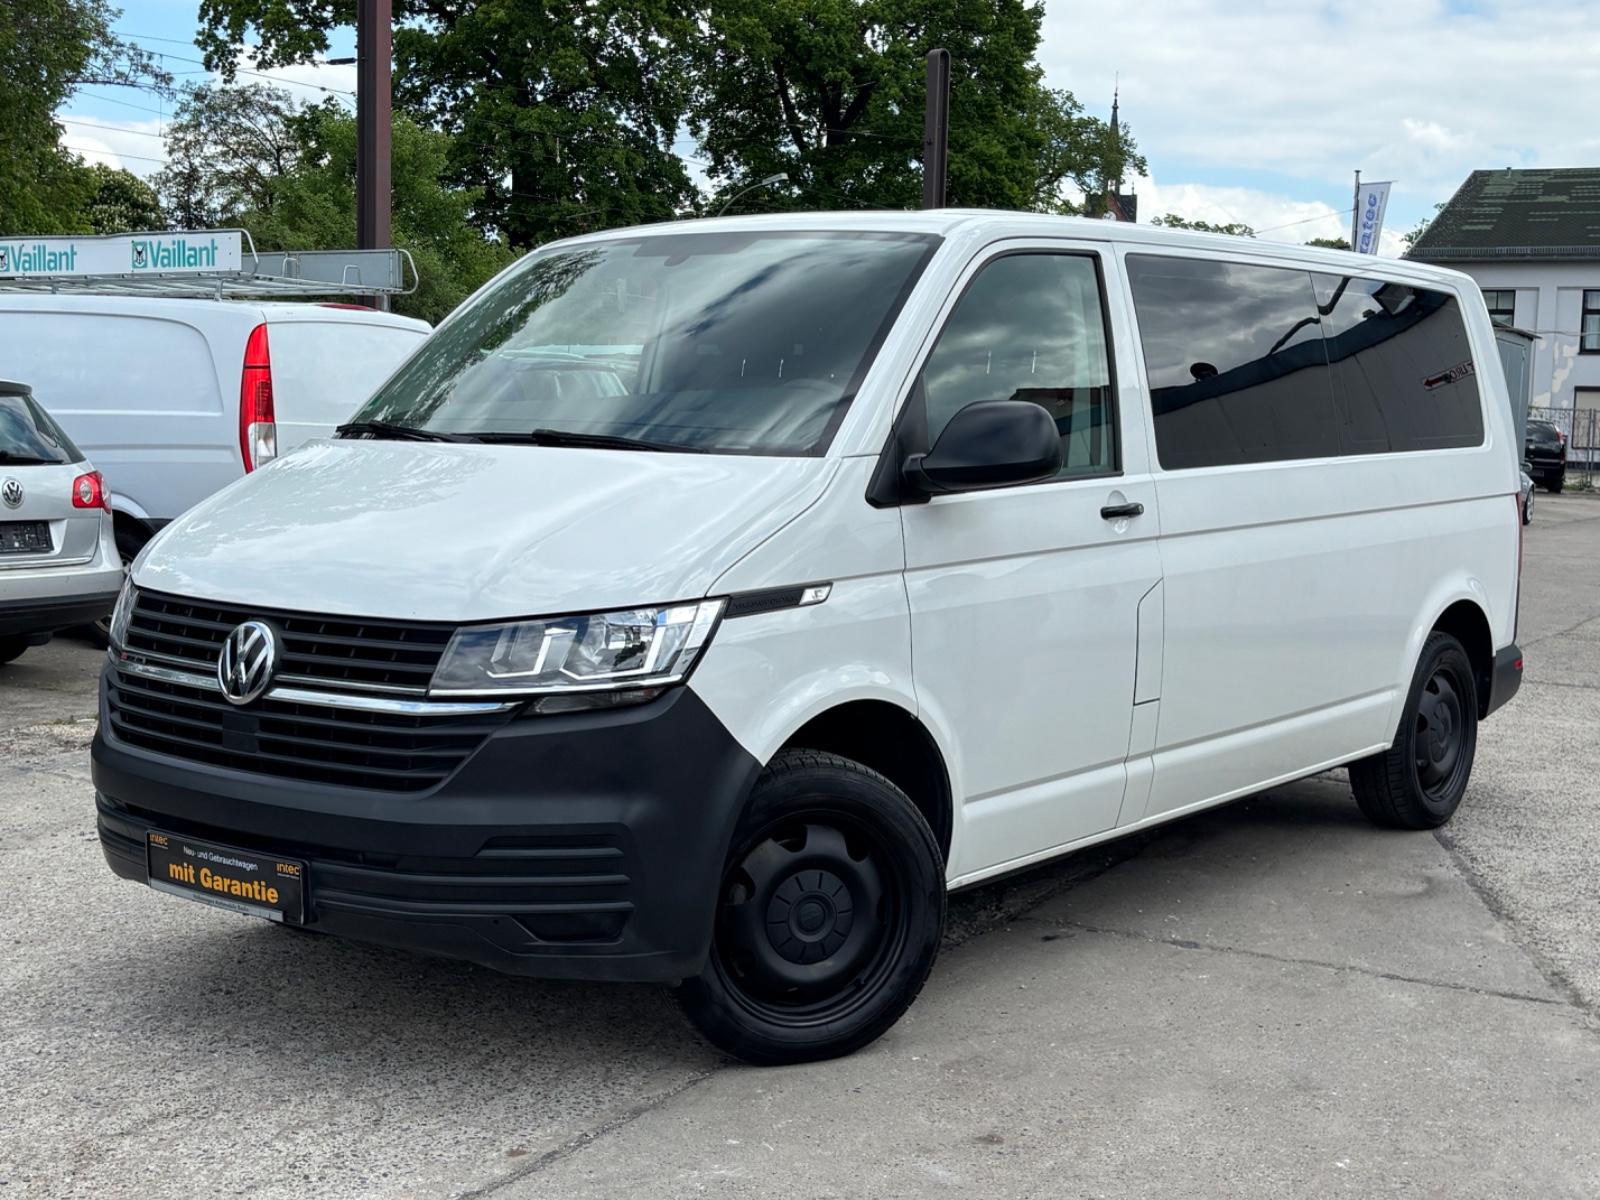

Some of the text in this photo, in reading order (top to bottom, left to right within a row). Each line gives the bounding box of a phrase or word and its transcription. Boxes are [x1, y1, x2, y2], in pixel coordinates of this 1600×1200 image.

[11, 244, 77, 272] Vaillant
[149, 238, 218, 269] Vaillant
[168, 862, 196, 884] mit
[200, 867, 279, 904] Garantie
